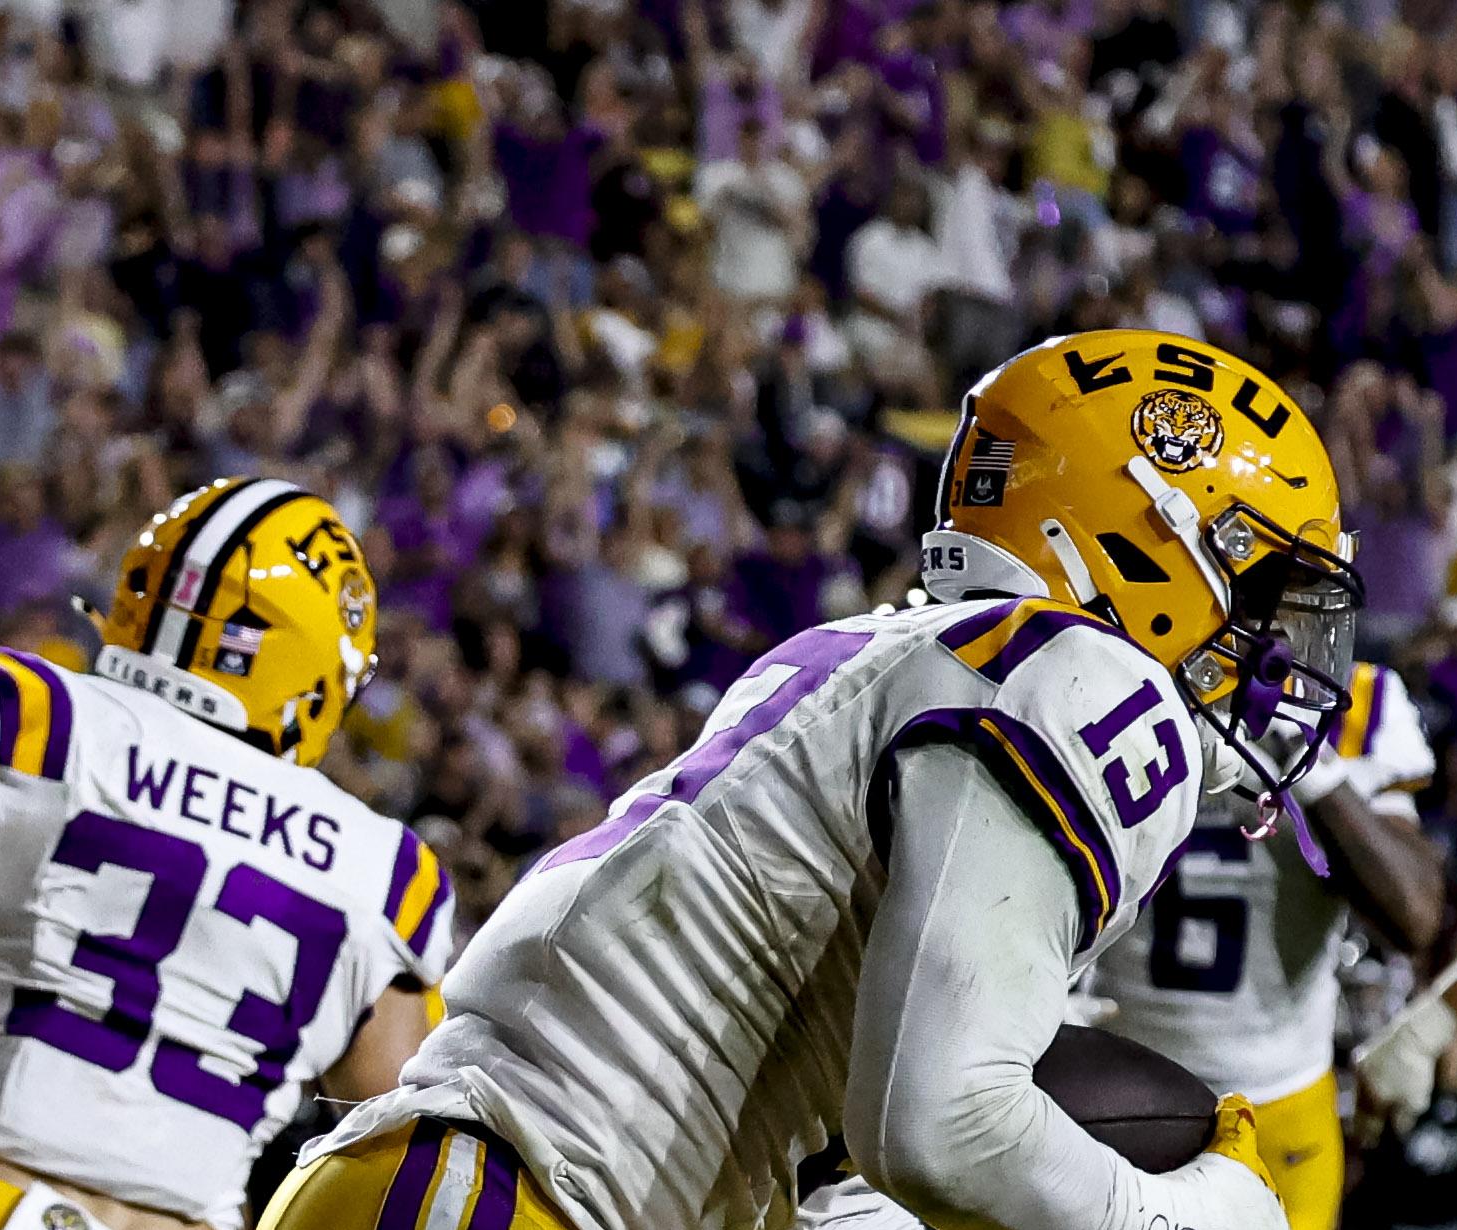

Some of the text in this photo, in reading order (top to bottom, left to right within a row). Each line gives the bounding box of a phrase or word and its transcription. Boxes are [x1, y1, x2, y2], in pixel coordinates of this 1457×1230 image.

[1062, 342, 1291, 439] LSU
[108, 655, 218, 716] TIGERS
[127, 745, 341, 873] WEEKS
[1079, 678, 1189, 830] 13
[5, 809, 348, 1134] 33
